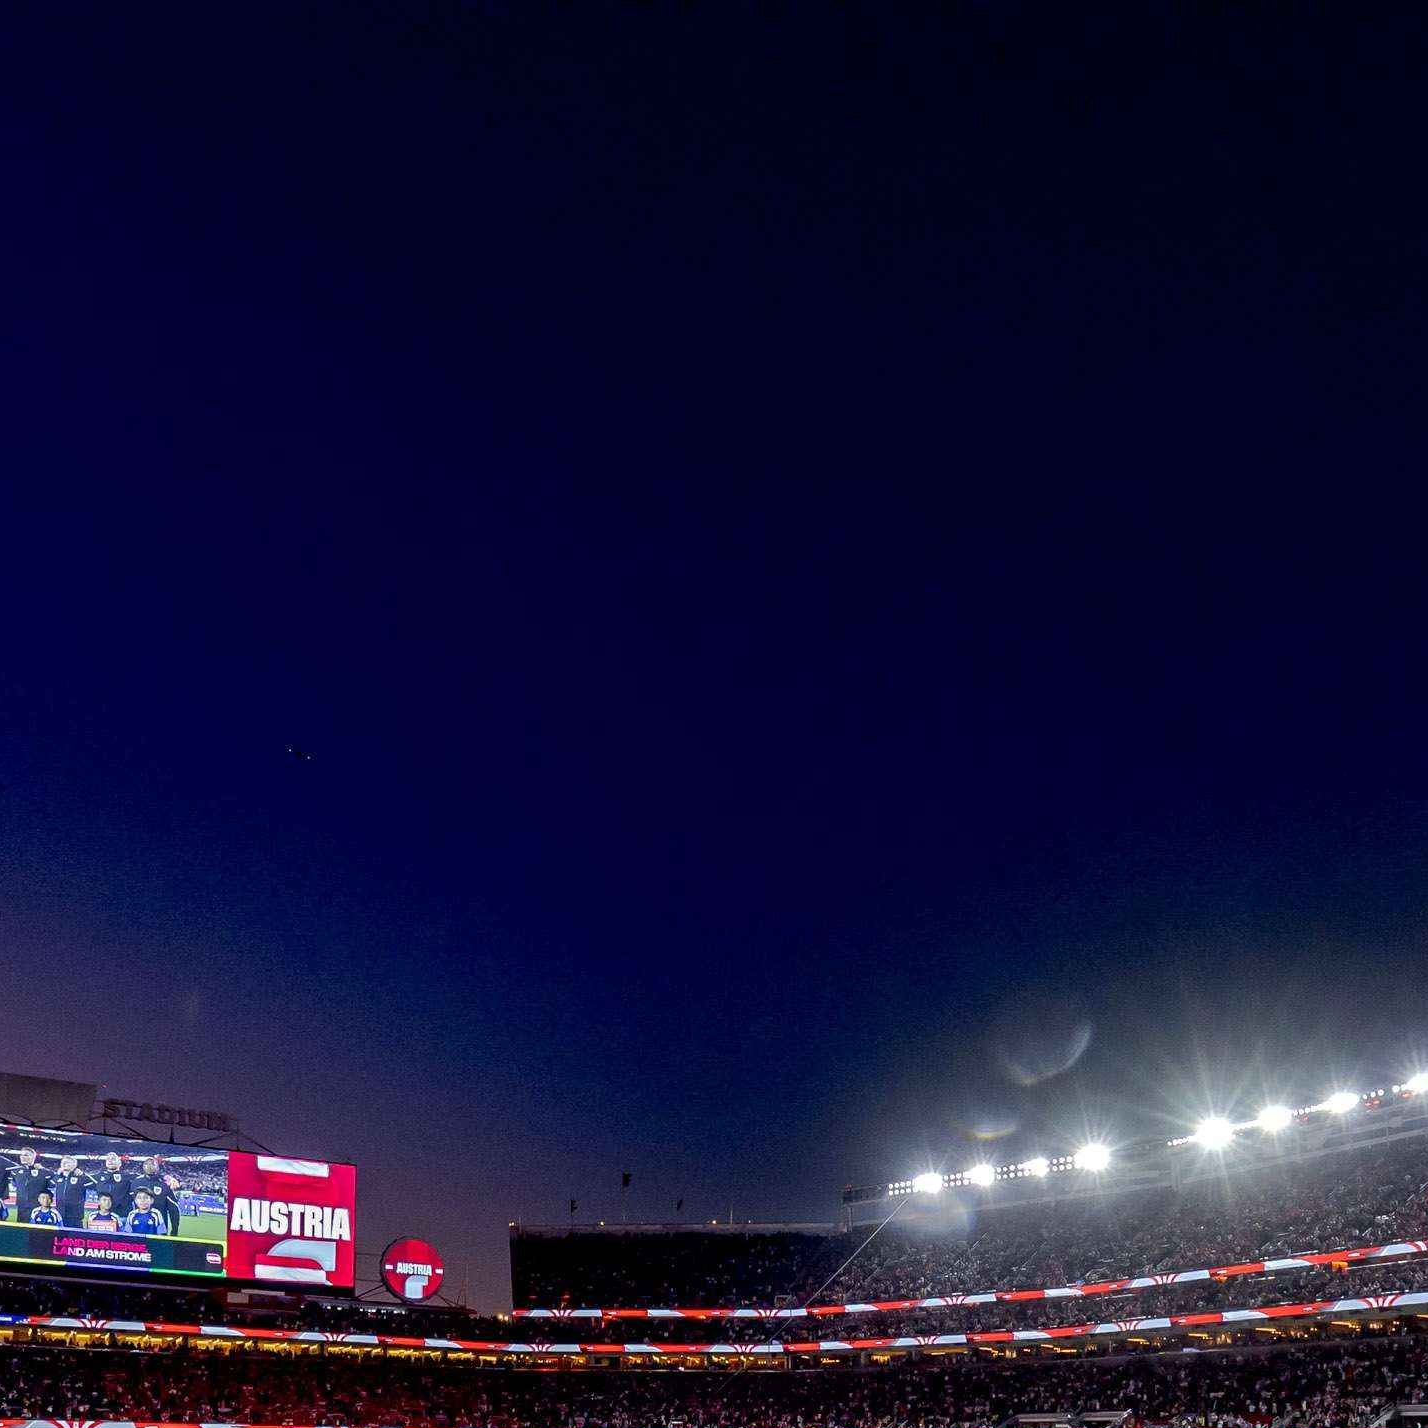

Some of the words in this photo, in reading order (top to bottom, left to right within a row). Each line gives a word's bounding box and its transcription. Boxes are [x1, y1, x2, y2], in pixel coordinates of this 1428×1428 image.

[230, 1198, 351, 1241] AUSTRIA
[53, 1236, 85, 1247] LAND
[53, 1246, 85, 1257] LAND
[86, 1248, 105, 1259] AM
[105, 1249, 151, 1262] STROME
[396, 1262, 433, 1275] AUSTRIA
